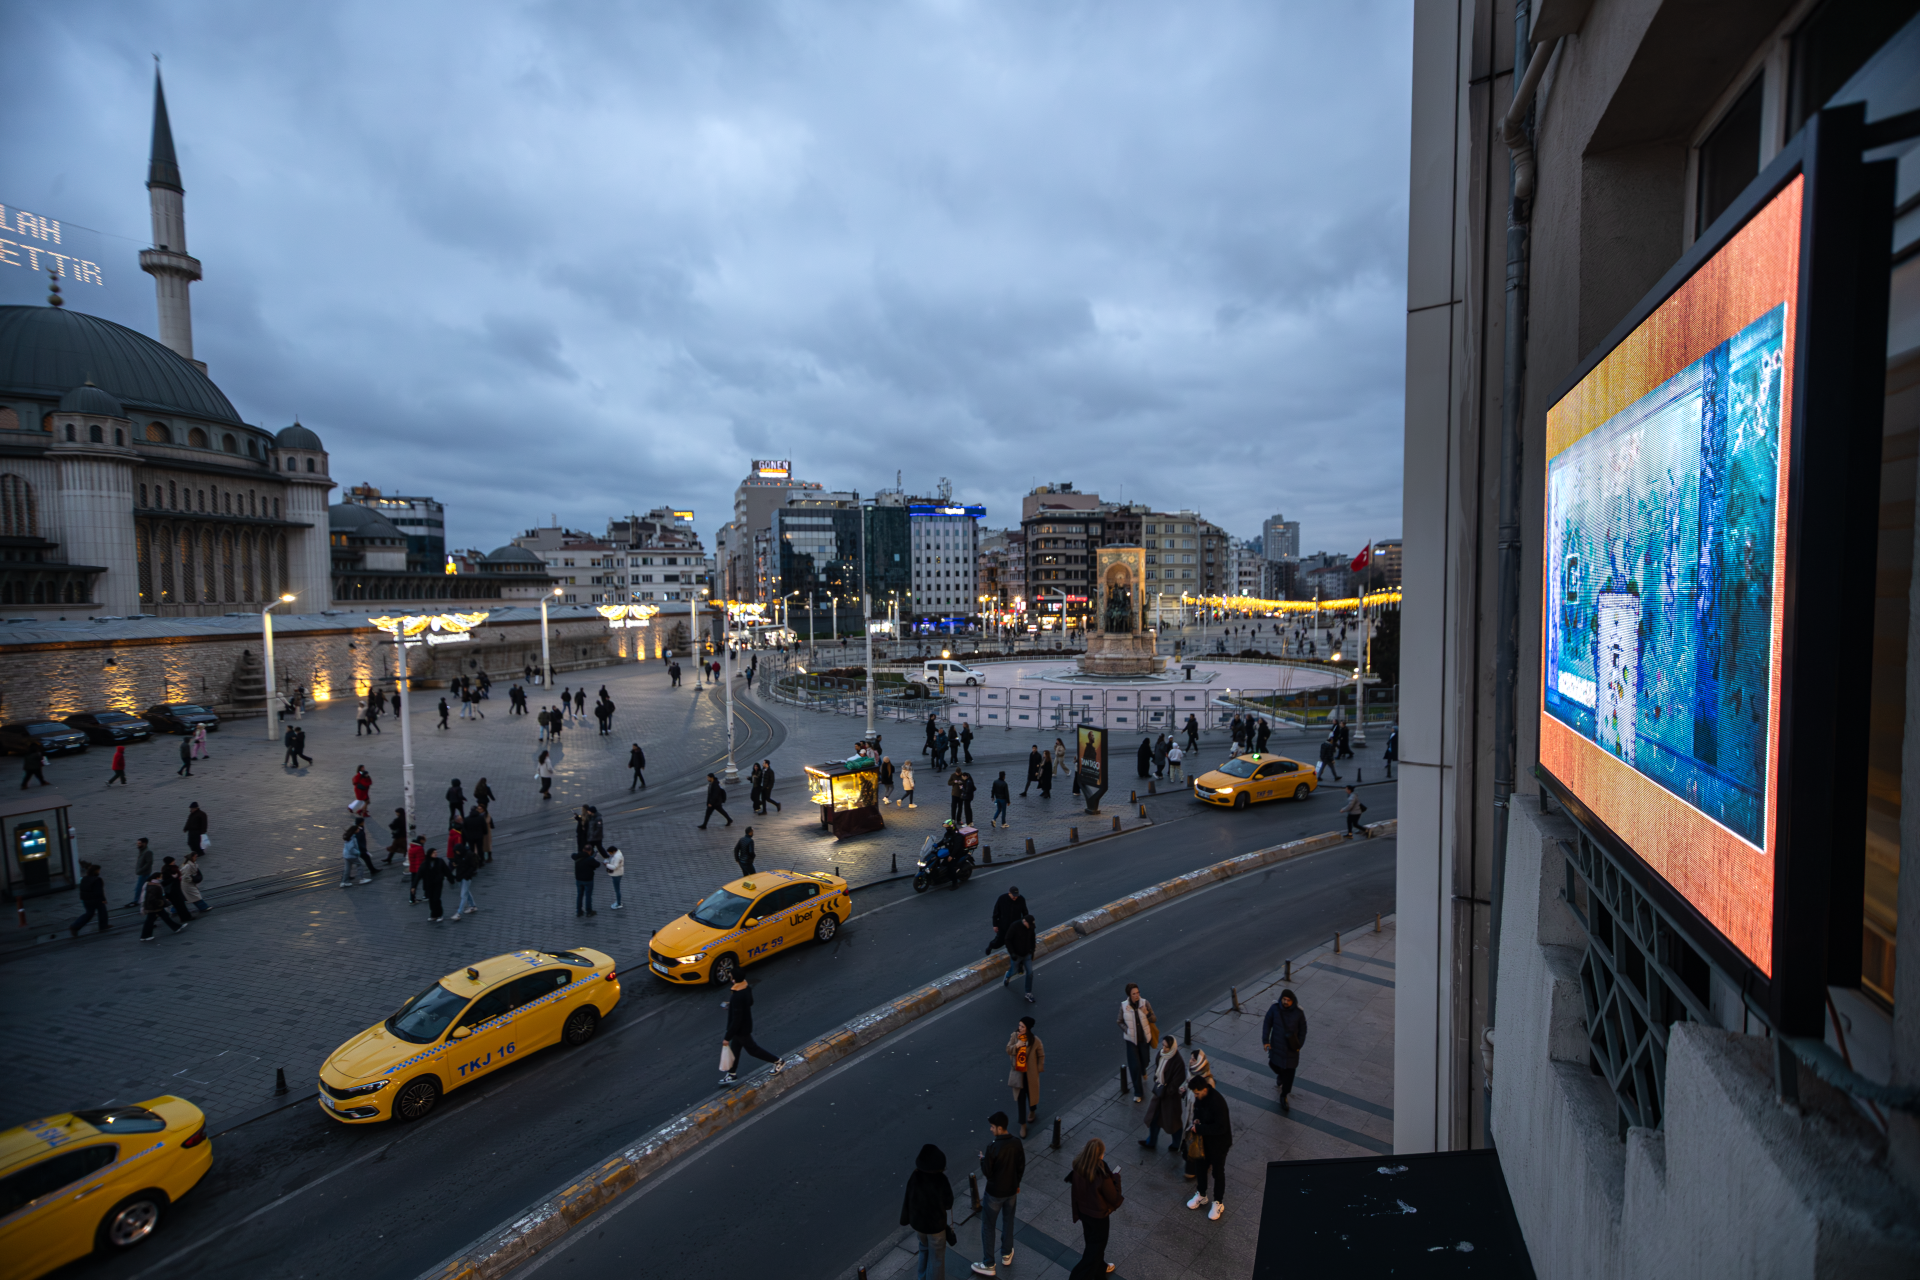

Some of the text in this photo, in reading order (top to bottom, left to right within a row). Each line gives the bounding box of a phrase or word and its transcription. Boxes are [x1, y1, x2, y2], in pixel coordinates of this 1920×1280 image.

[790, 910, 814, 927] Uber
[747, 936, 784, 958] TAZ 59
[457, 1042, 516, 1077] TKJ 16
